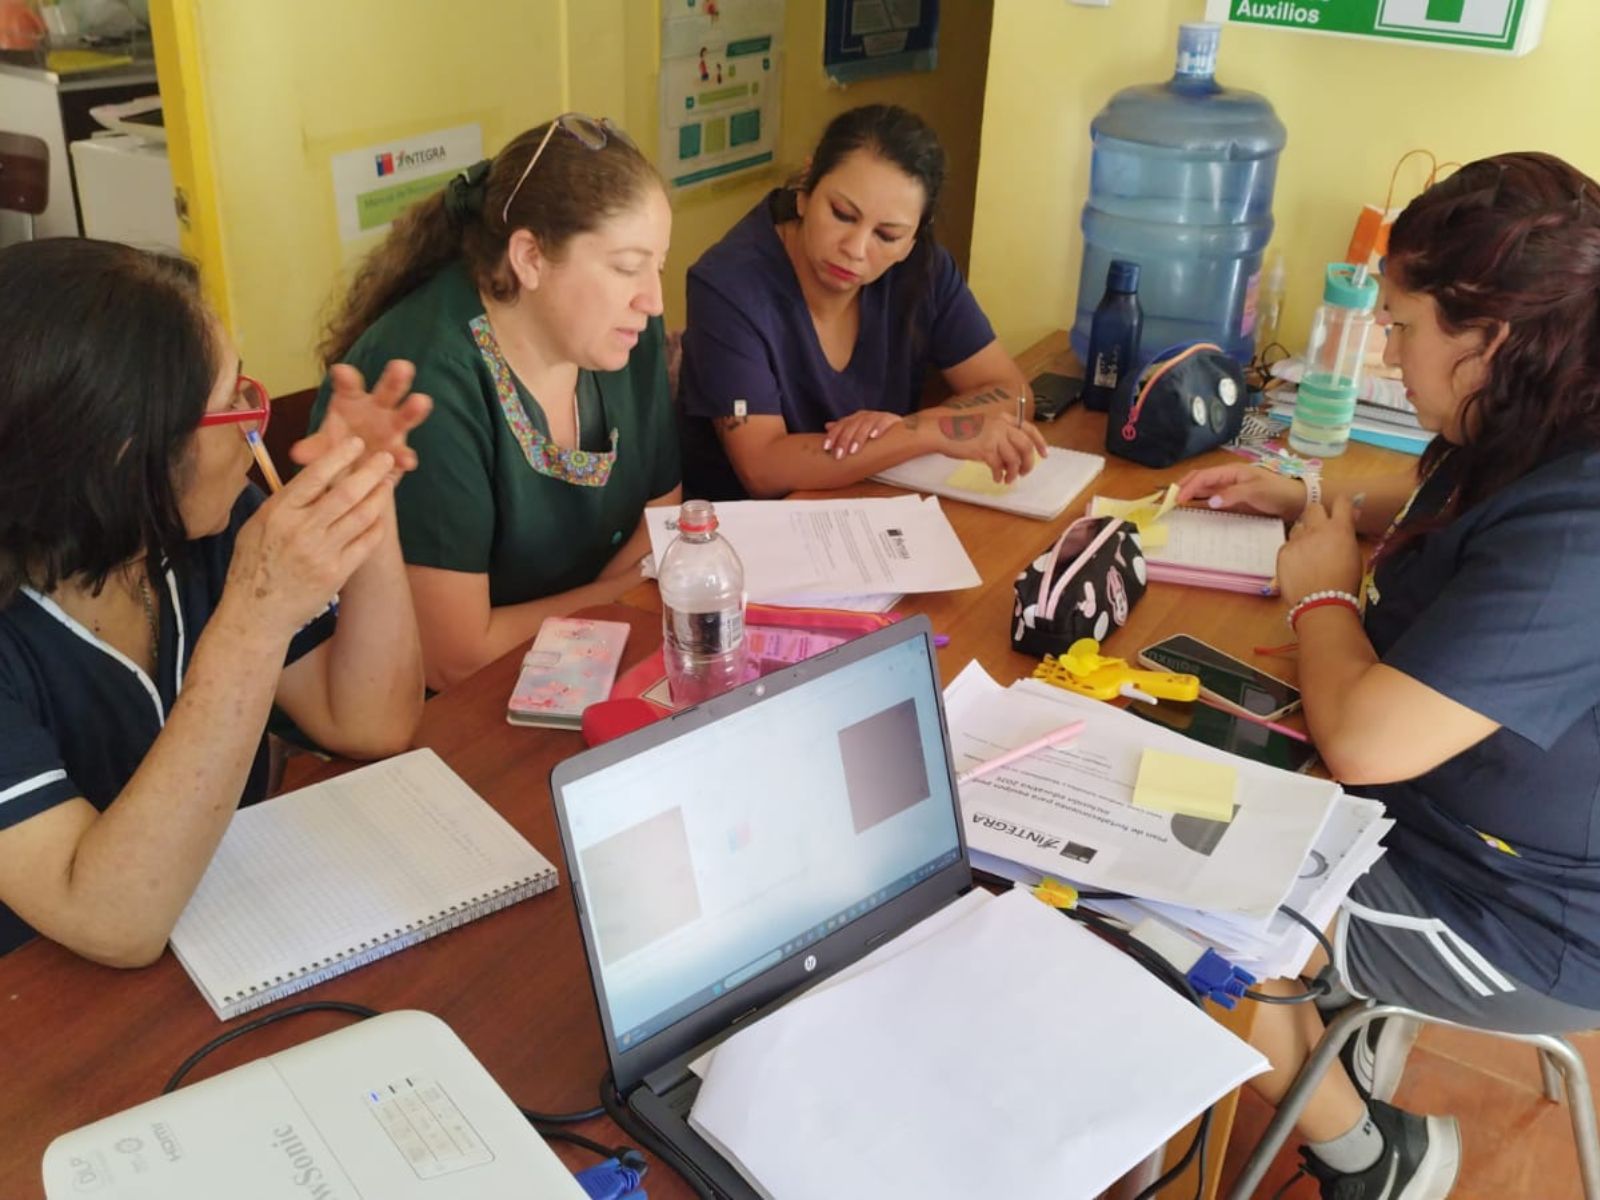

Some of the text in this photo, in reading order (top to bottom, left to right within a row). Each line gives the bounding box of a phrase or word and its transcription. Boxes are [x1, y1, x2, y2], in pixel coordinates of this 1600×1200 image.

[1236, 0, 1320, 24] Auxilios
[403, 145, 446, 167] INTEGRA
[1031, 793, 1054, 804] para
[972, 813, 1046, 846] INTEGRA
[1130, 827, 1144, 836] de
